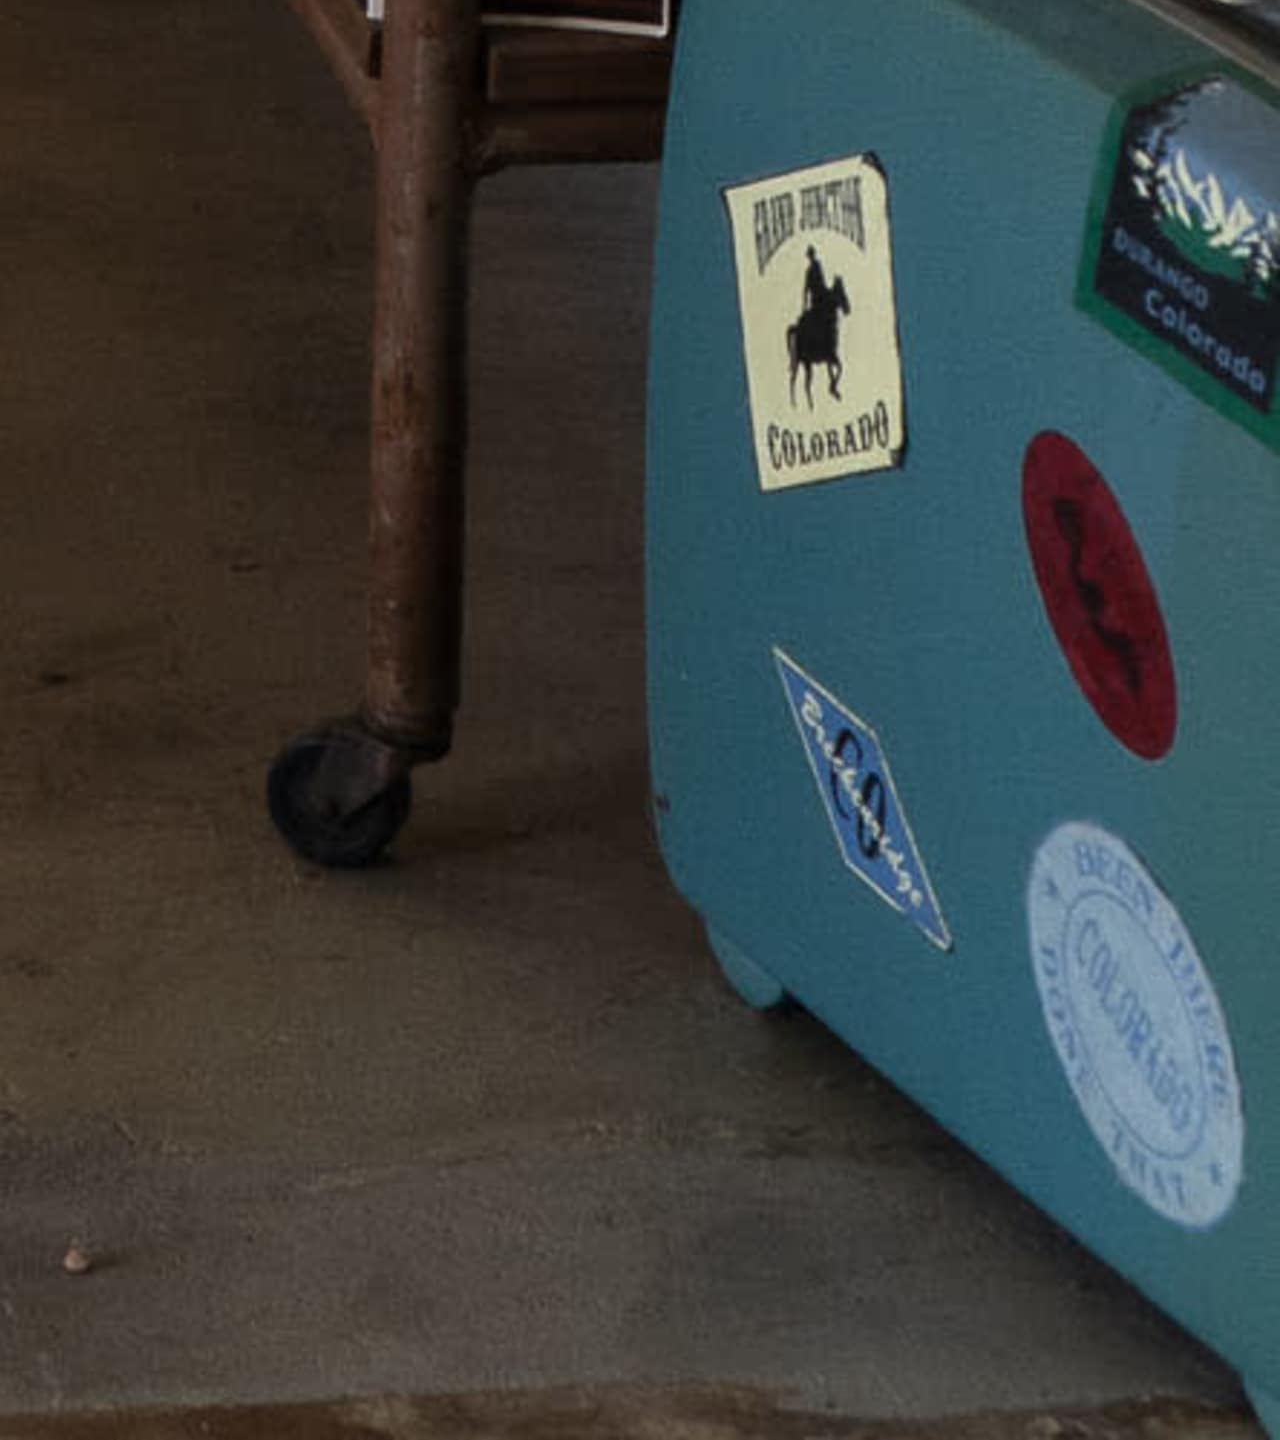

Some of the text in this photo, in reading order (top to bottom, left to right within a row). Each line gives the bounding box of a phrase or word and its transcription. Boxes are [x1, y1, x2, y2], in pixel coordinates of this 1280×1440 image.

[1110, 223, 1212, 313] DURANGO
[1142, 287, 1269, 395] Colorado
[765, 397, 891, 472] COLORADO
[1072, 839, 1156, 916] BEEN
[1074, 917, 1194, 1133] COLORADO
